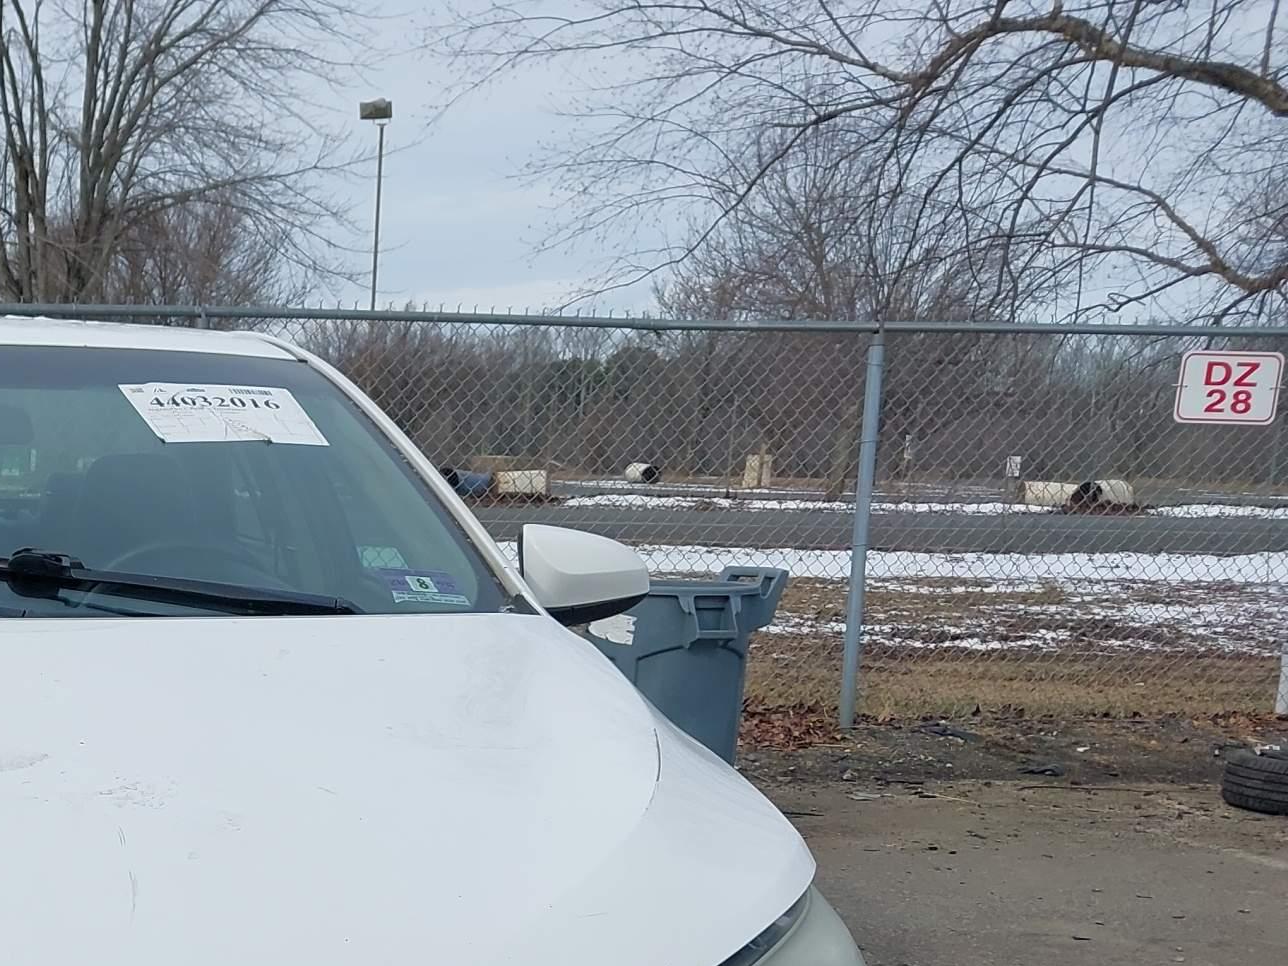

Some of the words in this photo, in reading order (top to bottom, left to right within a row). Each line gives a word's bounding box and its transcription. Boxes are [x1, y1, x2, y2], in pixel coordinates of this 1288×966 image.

[1203, 361, 1261, 387] DZ
[150, 393, 280, 410] 44032016
[1203, 389, 1252, 414] 28
[416, 578, 429, 589] 8
